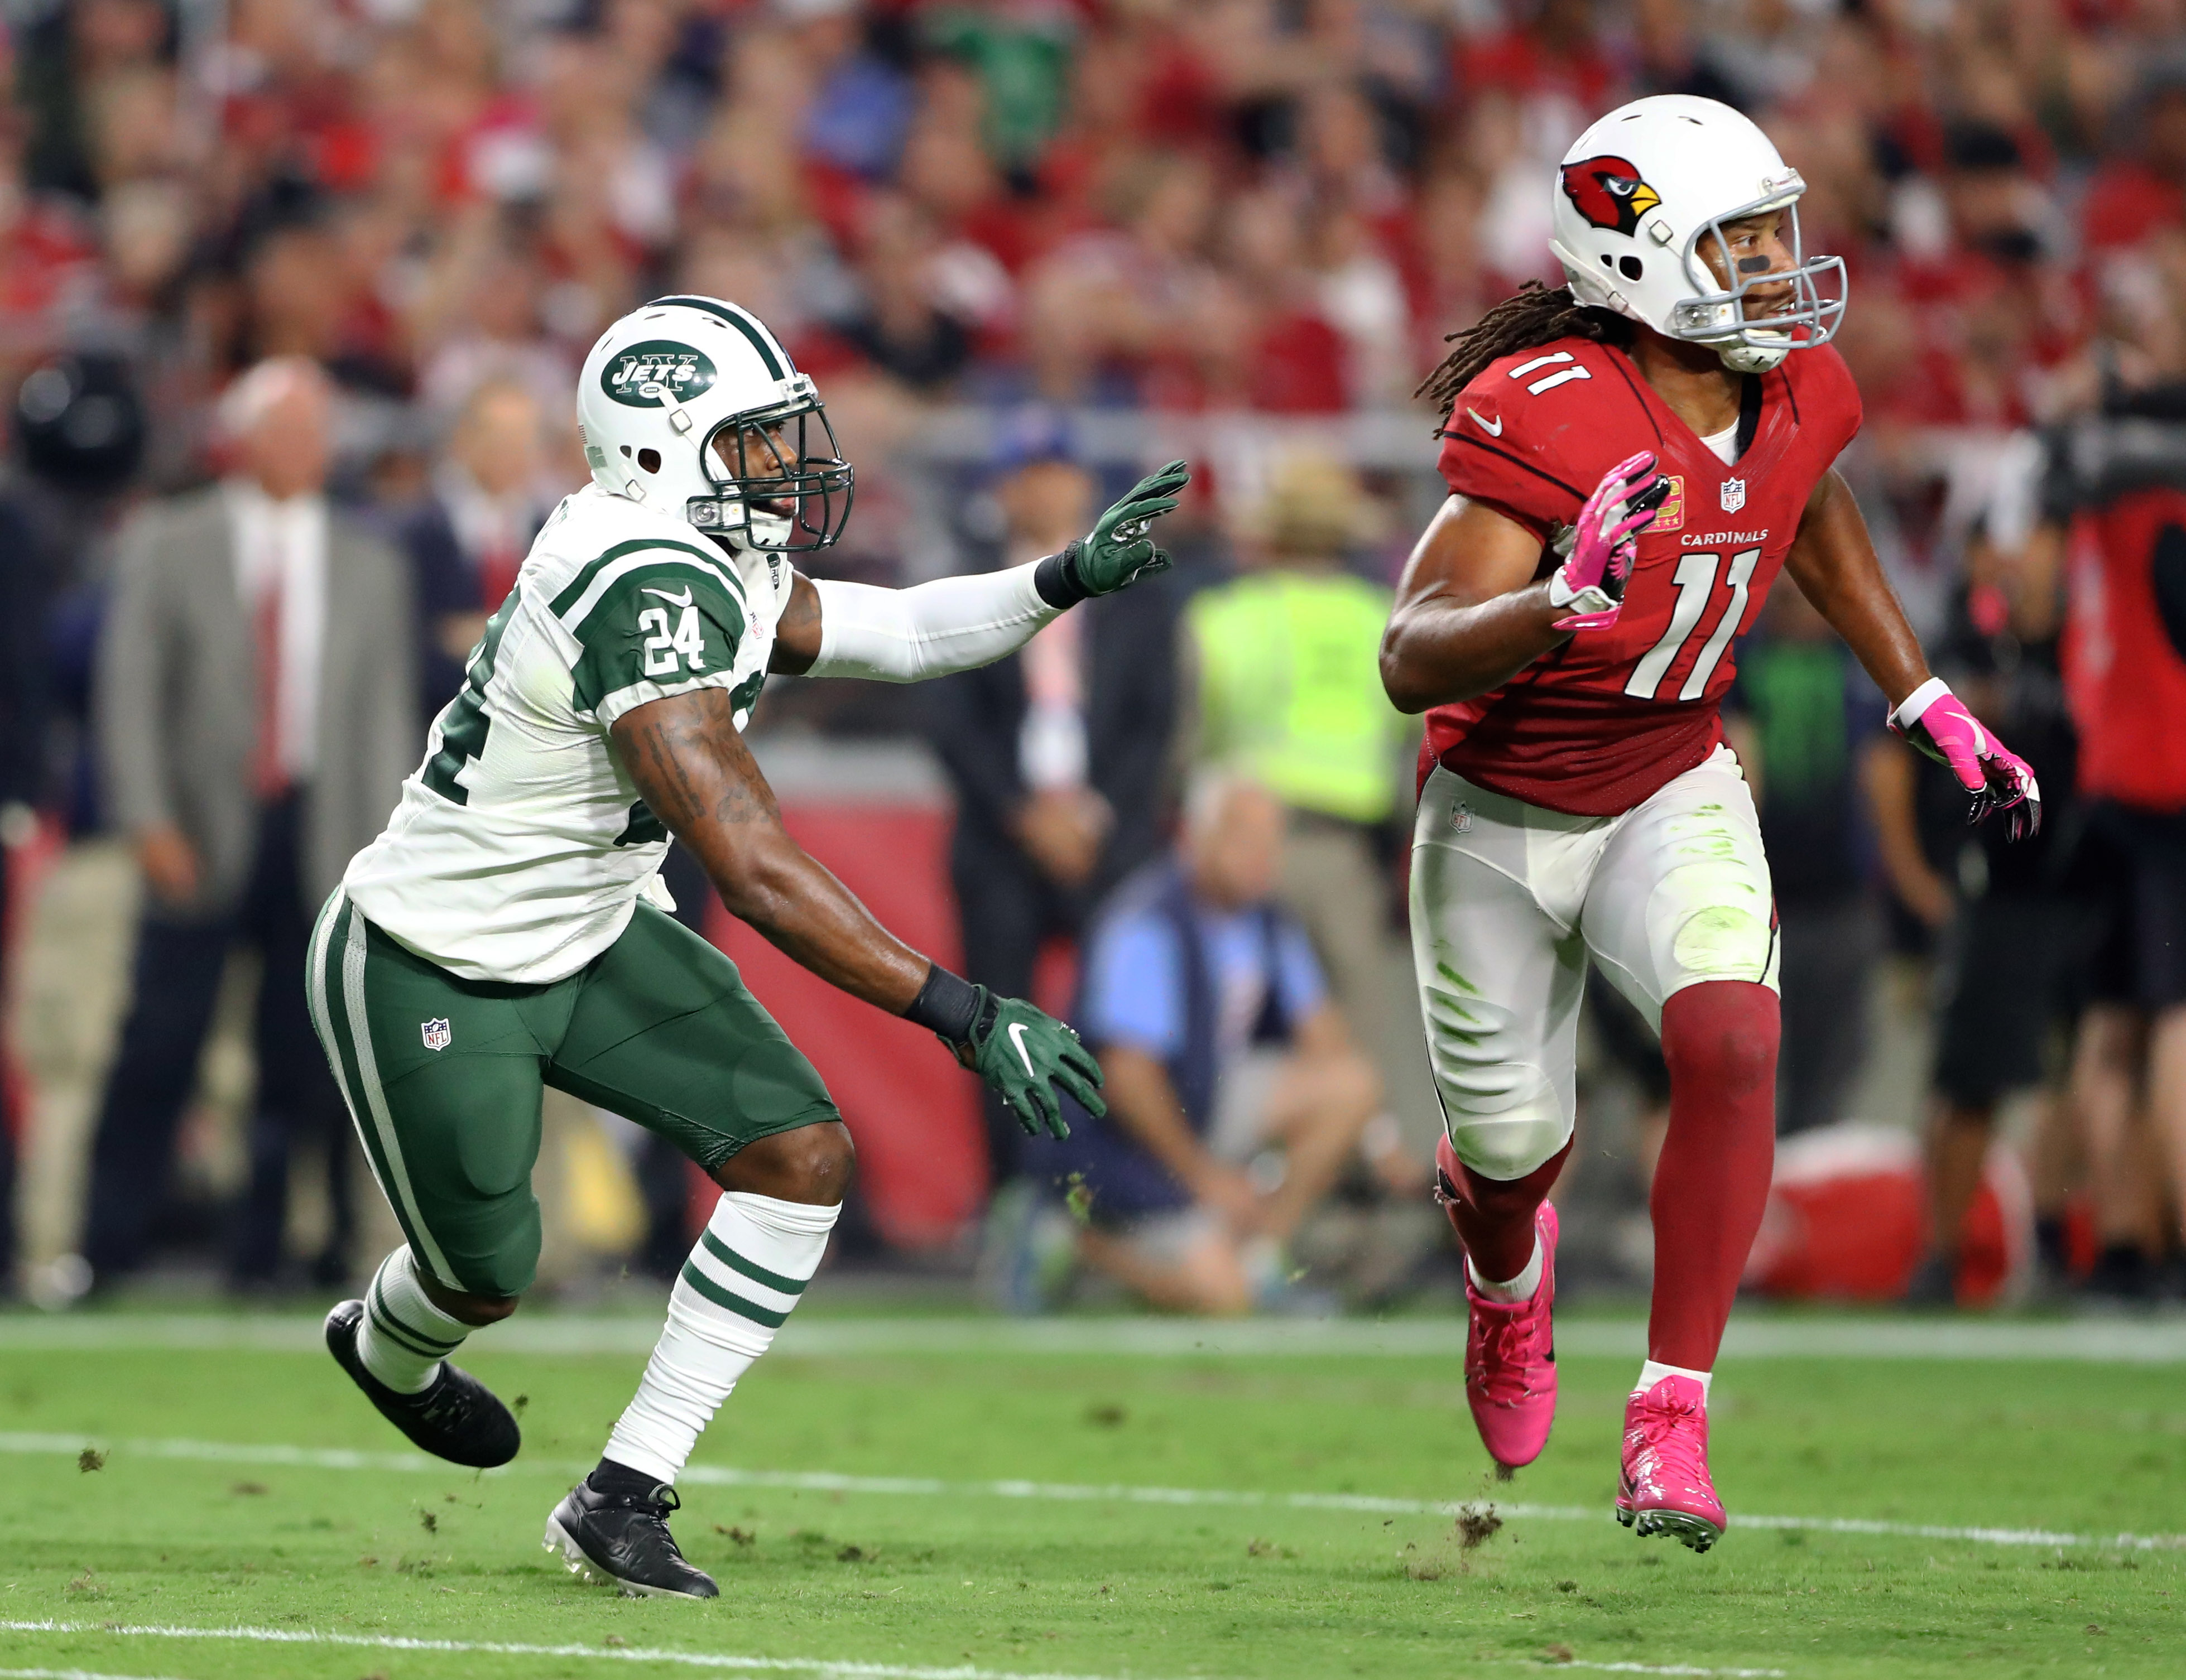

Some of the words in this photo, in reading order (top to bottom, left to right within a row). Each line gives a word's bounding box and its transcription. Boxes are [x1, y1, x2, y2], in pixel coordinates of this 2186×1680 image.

[612, 362, 696, 384] JETS
[1508, 351, 1592, 396] 11
[1725, 494, 1741, 507] NFL
[1680, 529, 1769, 546] CARDINALS
[1624, 546, 1761, 701] 11
[638, 606, 707, 676] 24
[427, 1032, 446, 1044] NFL
